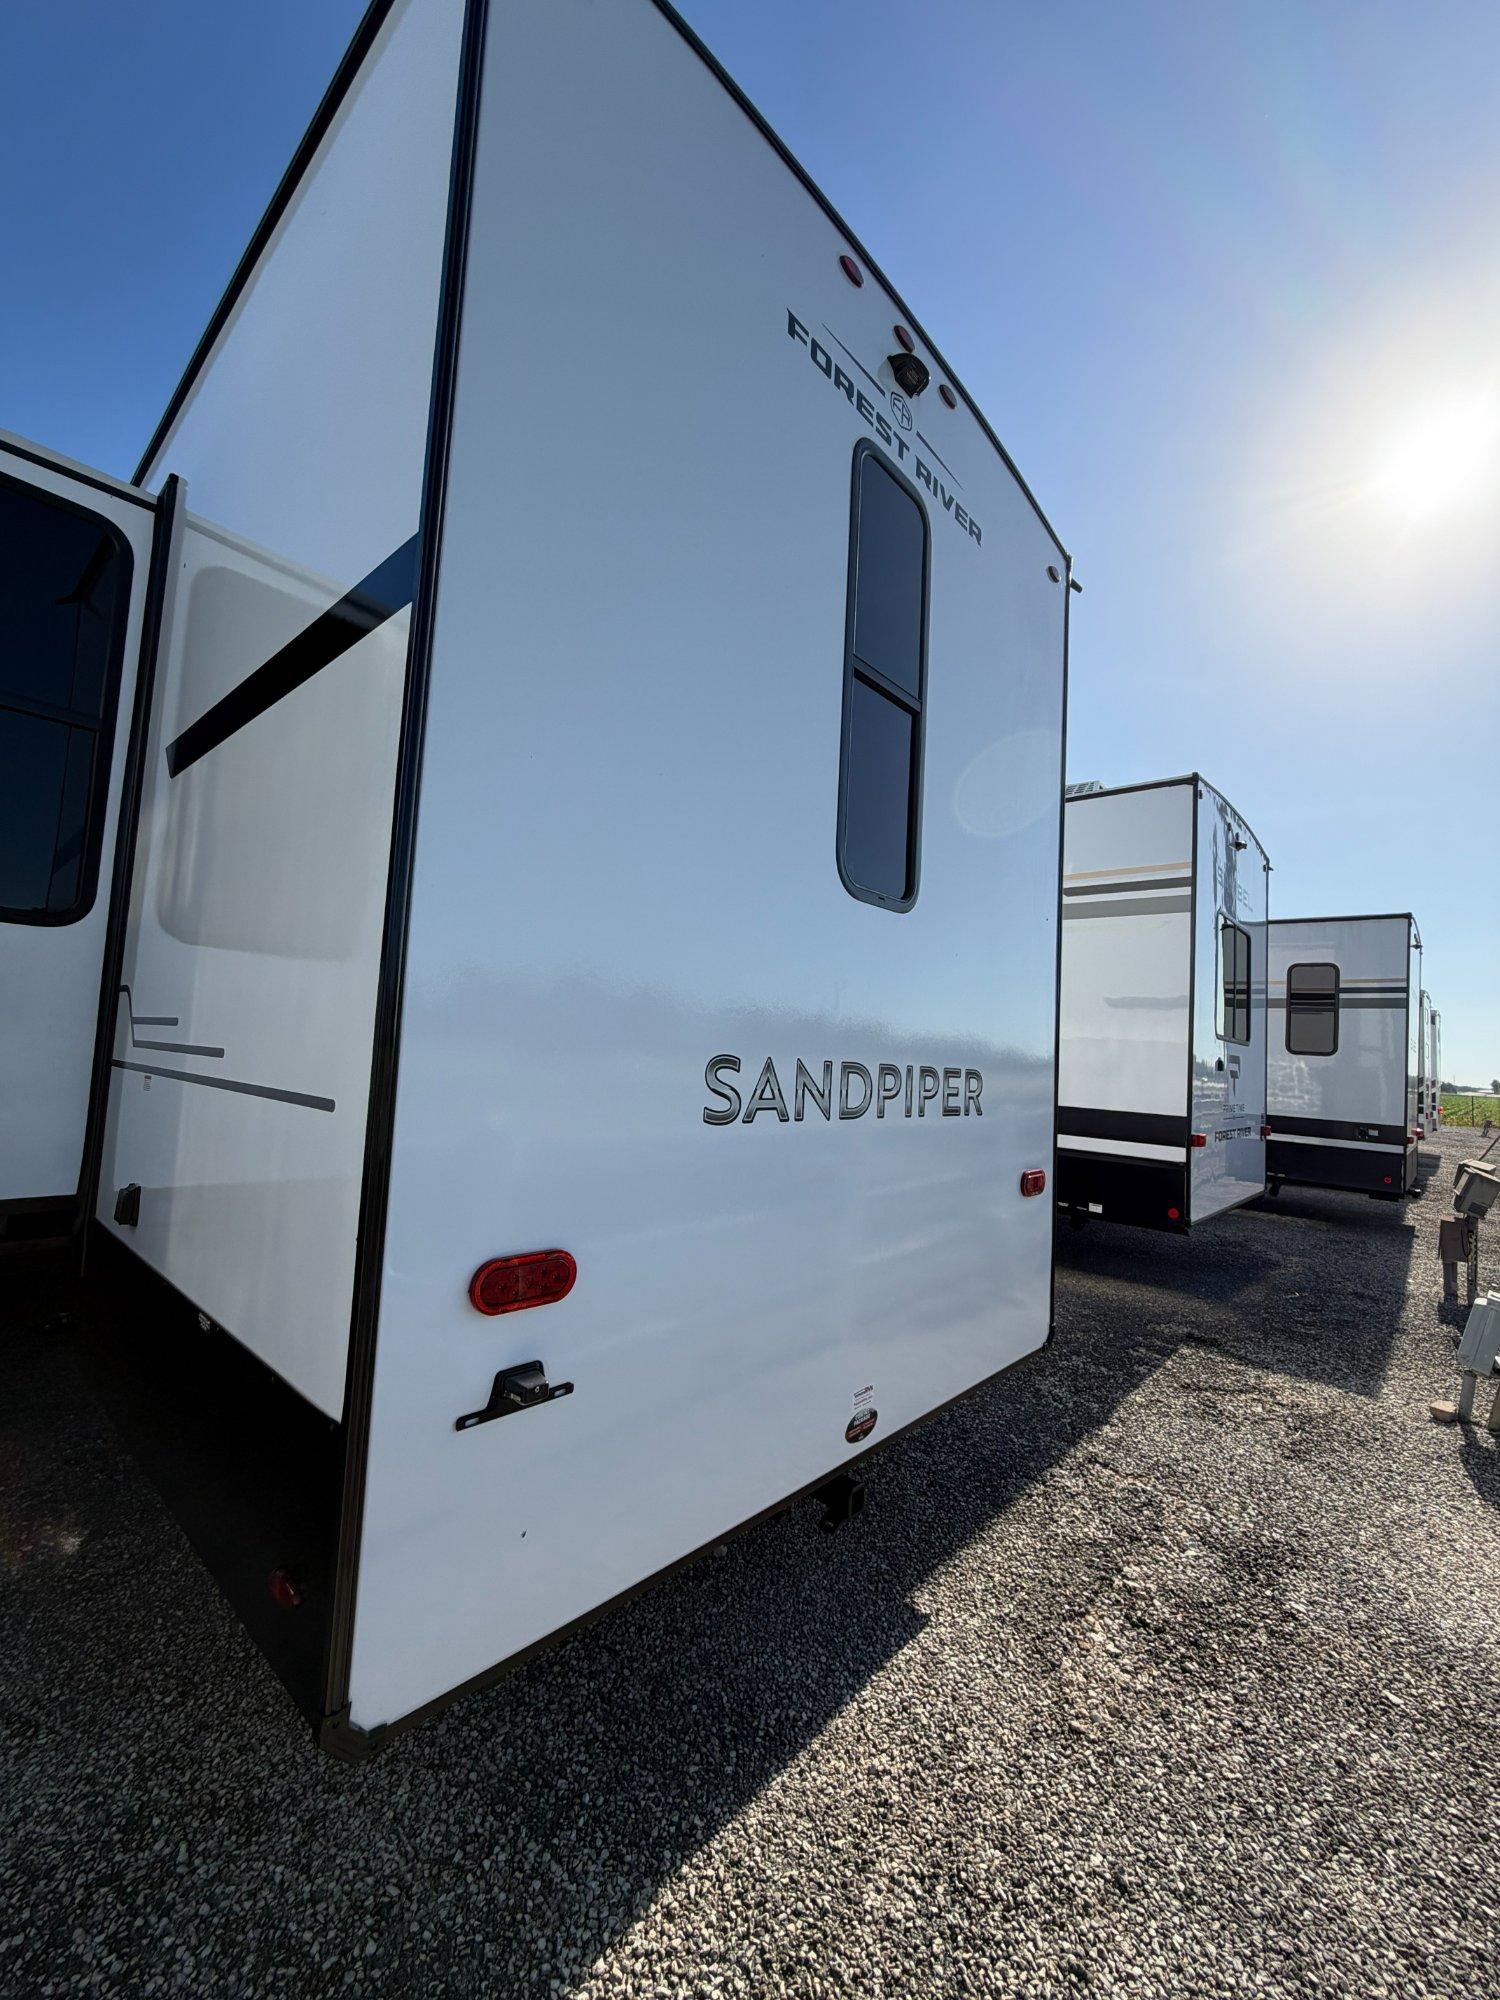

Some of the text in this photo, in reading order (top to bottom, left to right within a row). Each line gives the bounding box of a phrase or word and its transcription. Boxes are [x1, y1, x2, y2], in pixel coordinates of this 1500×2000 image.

[787, 308, 982, 548] FOREST RIVER
[703, 1054, 983, 1126] SANDPIPER
[1215, 1127, 1251, 1142] FOREST RIVER
